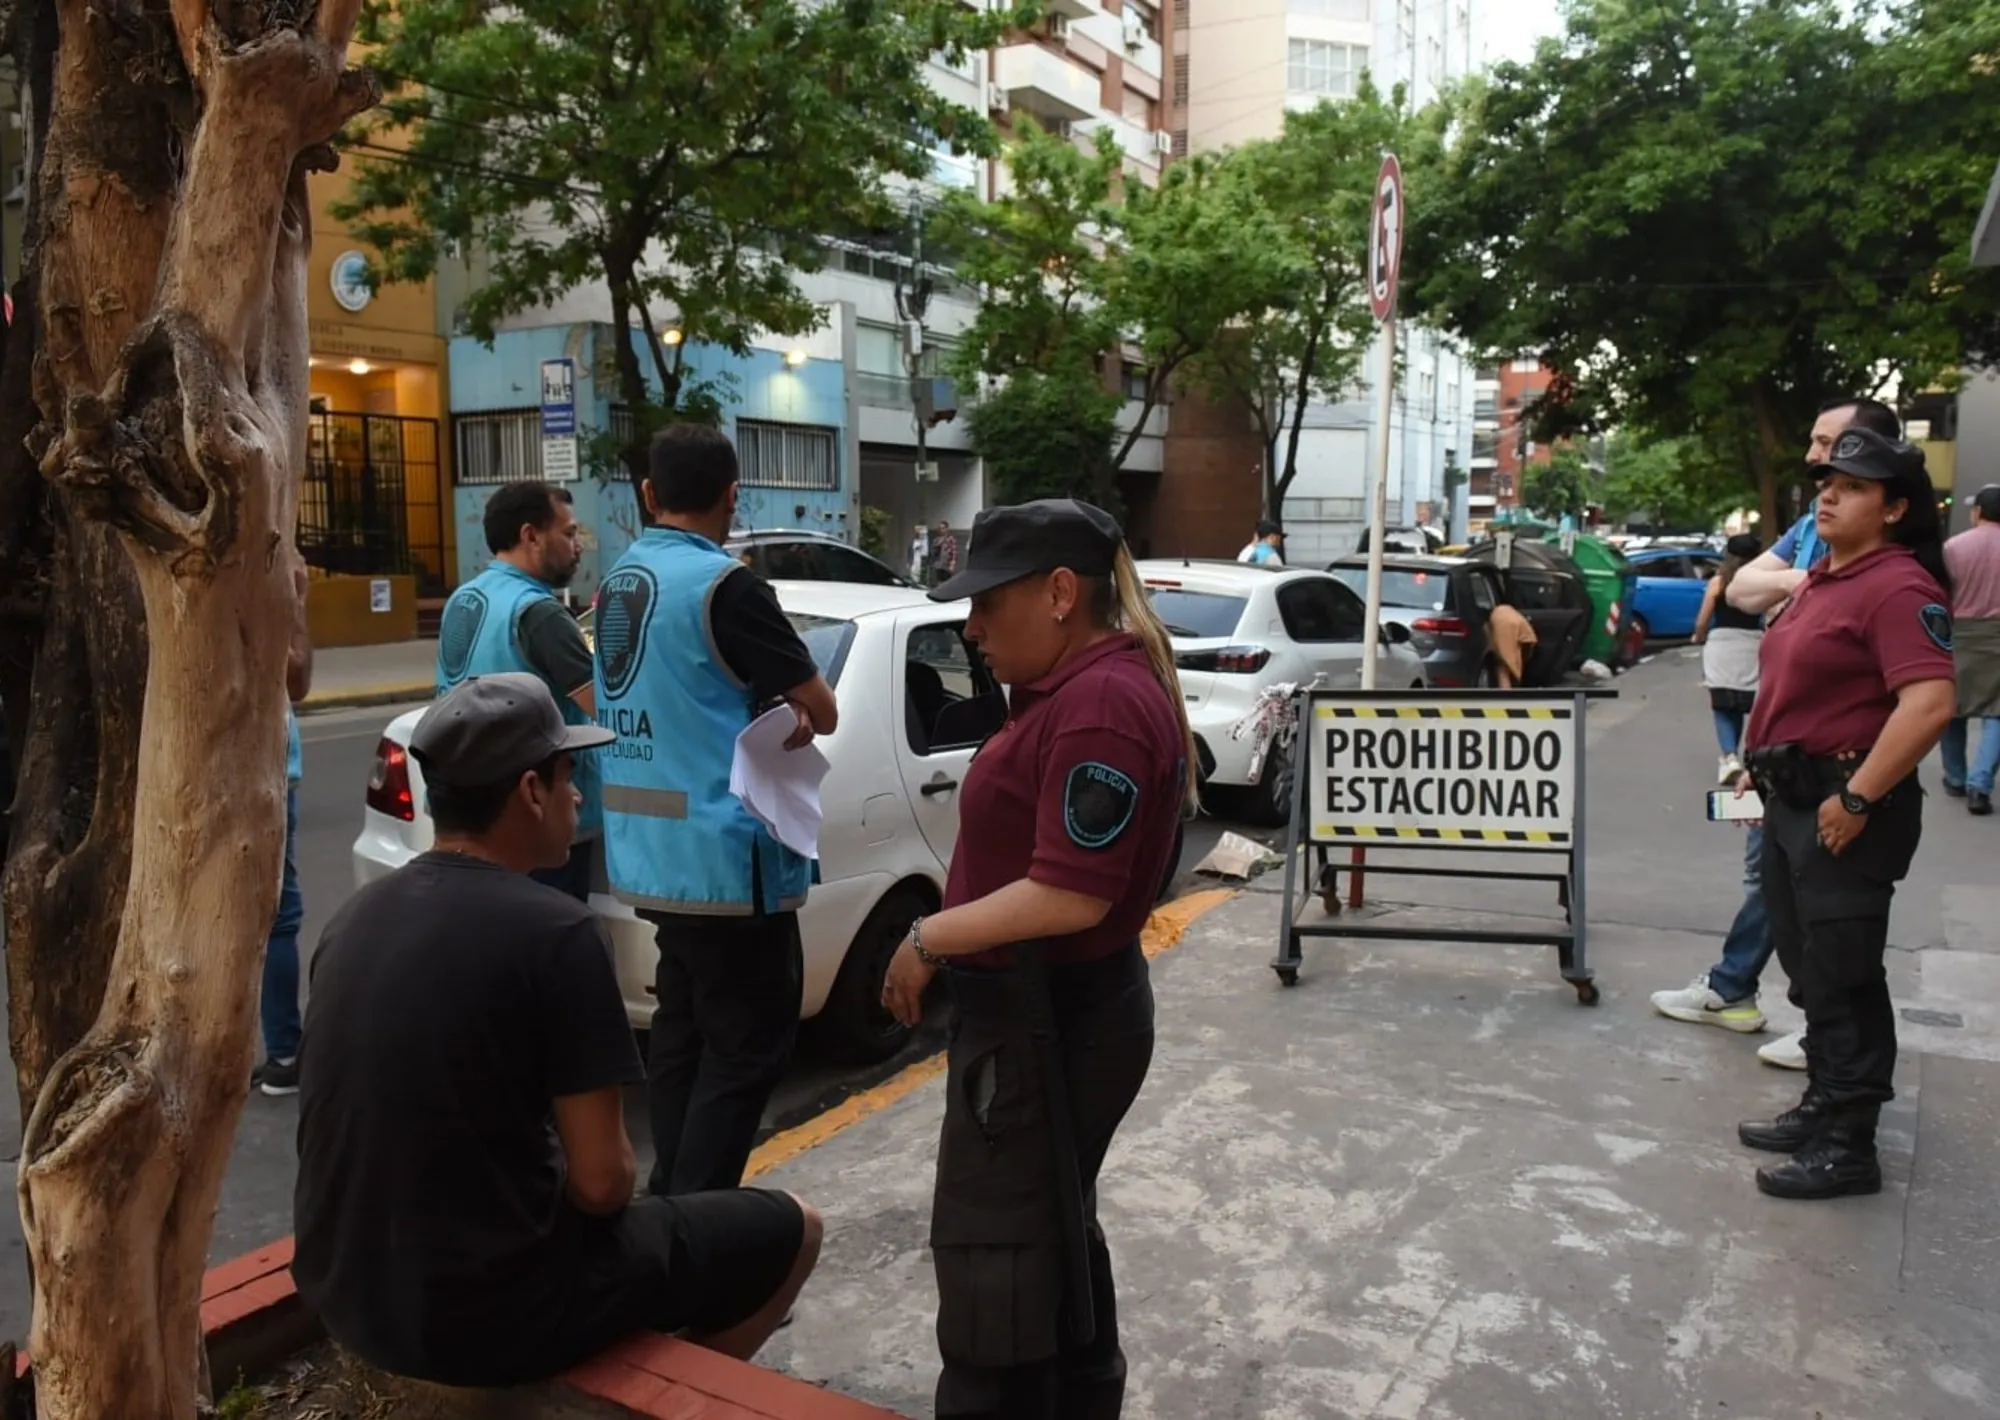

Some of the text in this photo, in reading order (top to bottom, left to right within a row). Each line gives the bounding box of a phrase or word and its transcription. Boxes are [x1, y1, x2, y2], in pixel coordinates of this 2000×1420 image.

[598, 708, 653, 740] LICIA
[1326, 728, 1561, 771] PROHIBIDO
[1087, 767, 1127, 794] POLICIA
[1326, 776, 1560, 818] ESTACIONAR
